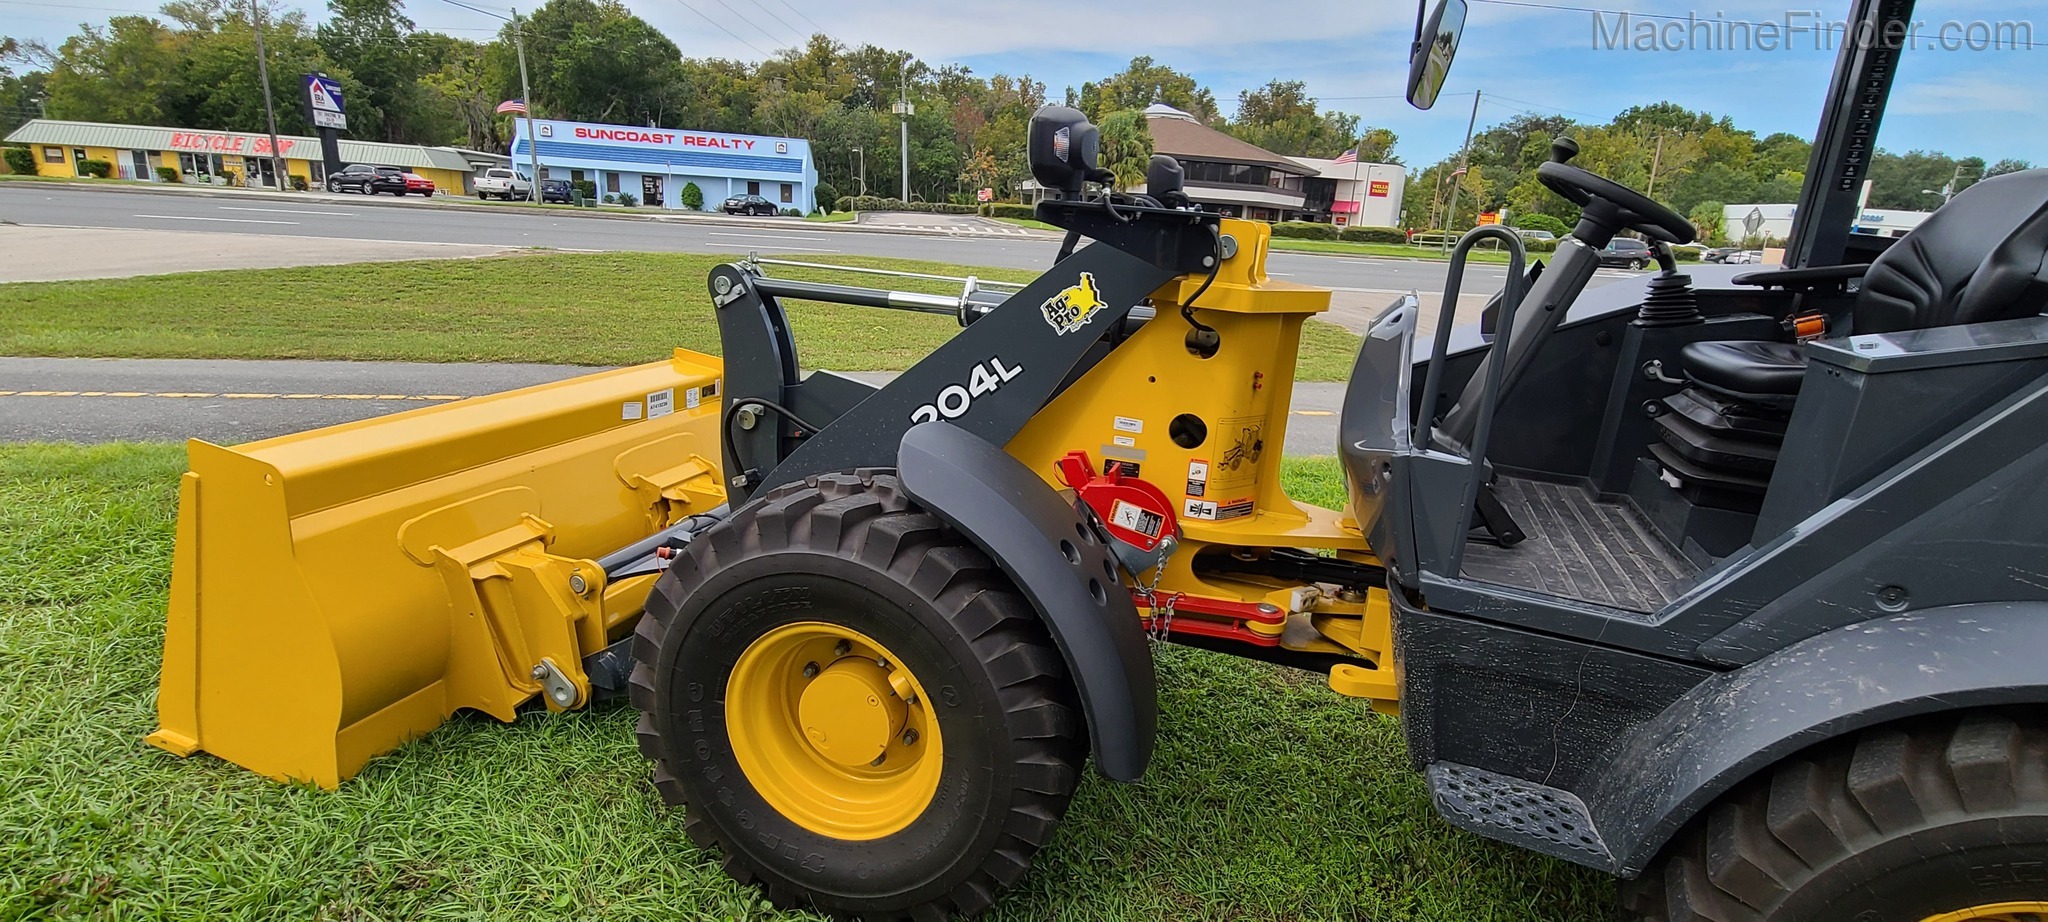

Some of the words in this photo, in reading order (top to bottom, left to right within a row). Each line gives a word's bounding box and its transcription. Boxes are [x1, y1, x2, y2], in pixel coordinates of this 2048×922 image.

[170, 132, 246, 151] BICYCLE
[252, 137, 295, 154] SHOP
[575, 127, 675, 145] SUNCOAST
[683, 135, 755, 151] REALTY
[1045, 295, 1069, 319] Ag-
[1053, 306, 1080, 331] Pro
[911, 358, 1022, 425] 204L
